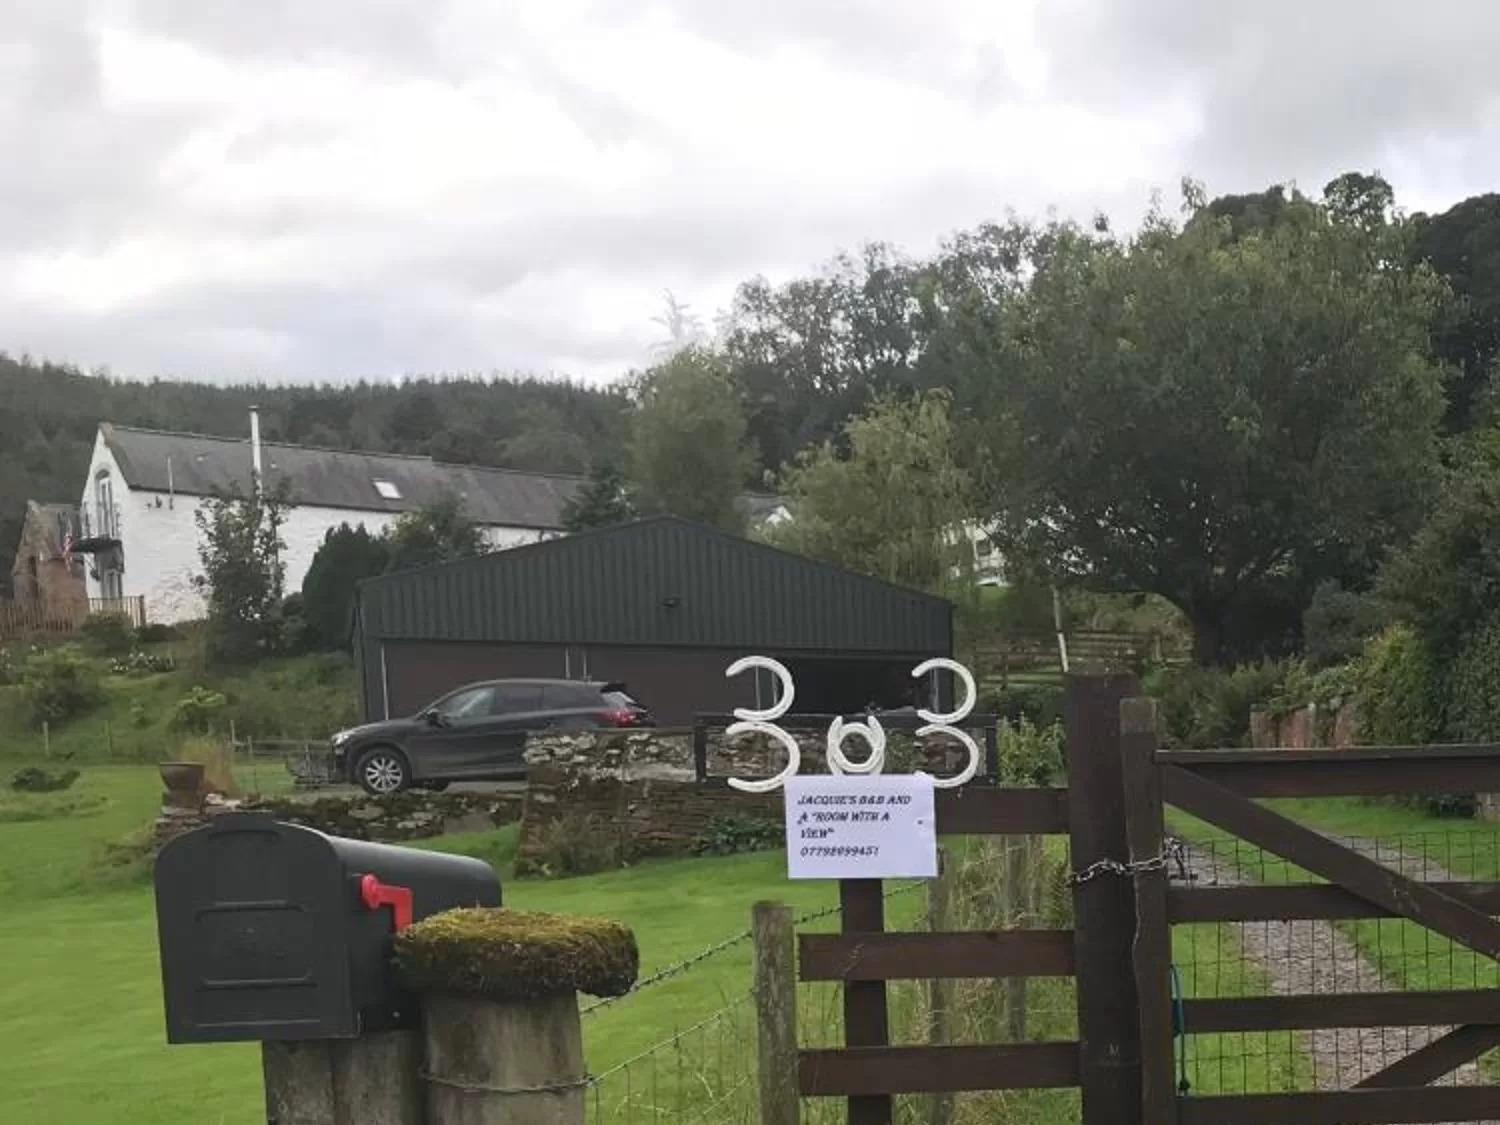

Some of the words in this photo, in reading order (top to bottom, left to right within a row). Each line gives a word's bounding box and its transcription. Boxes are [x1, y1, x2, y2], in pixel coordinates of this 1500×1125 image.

[858, 795, 884, 805] B&B
[887, 795, 912, 805] AND
[800, 811, 808, 822] A
[851, 811, 880, 822] WITH
[881, 811, 890, 822] A
